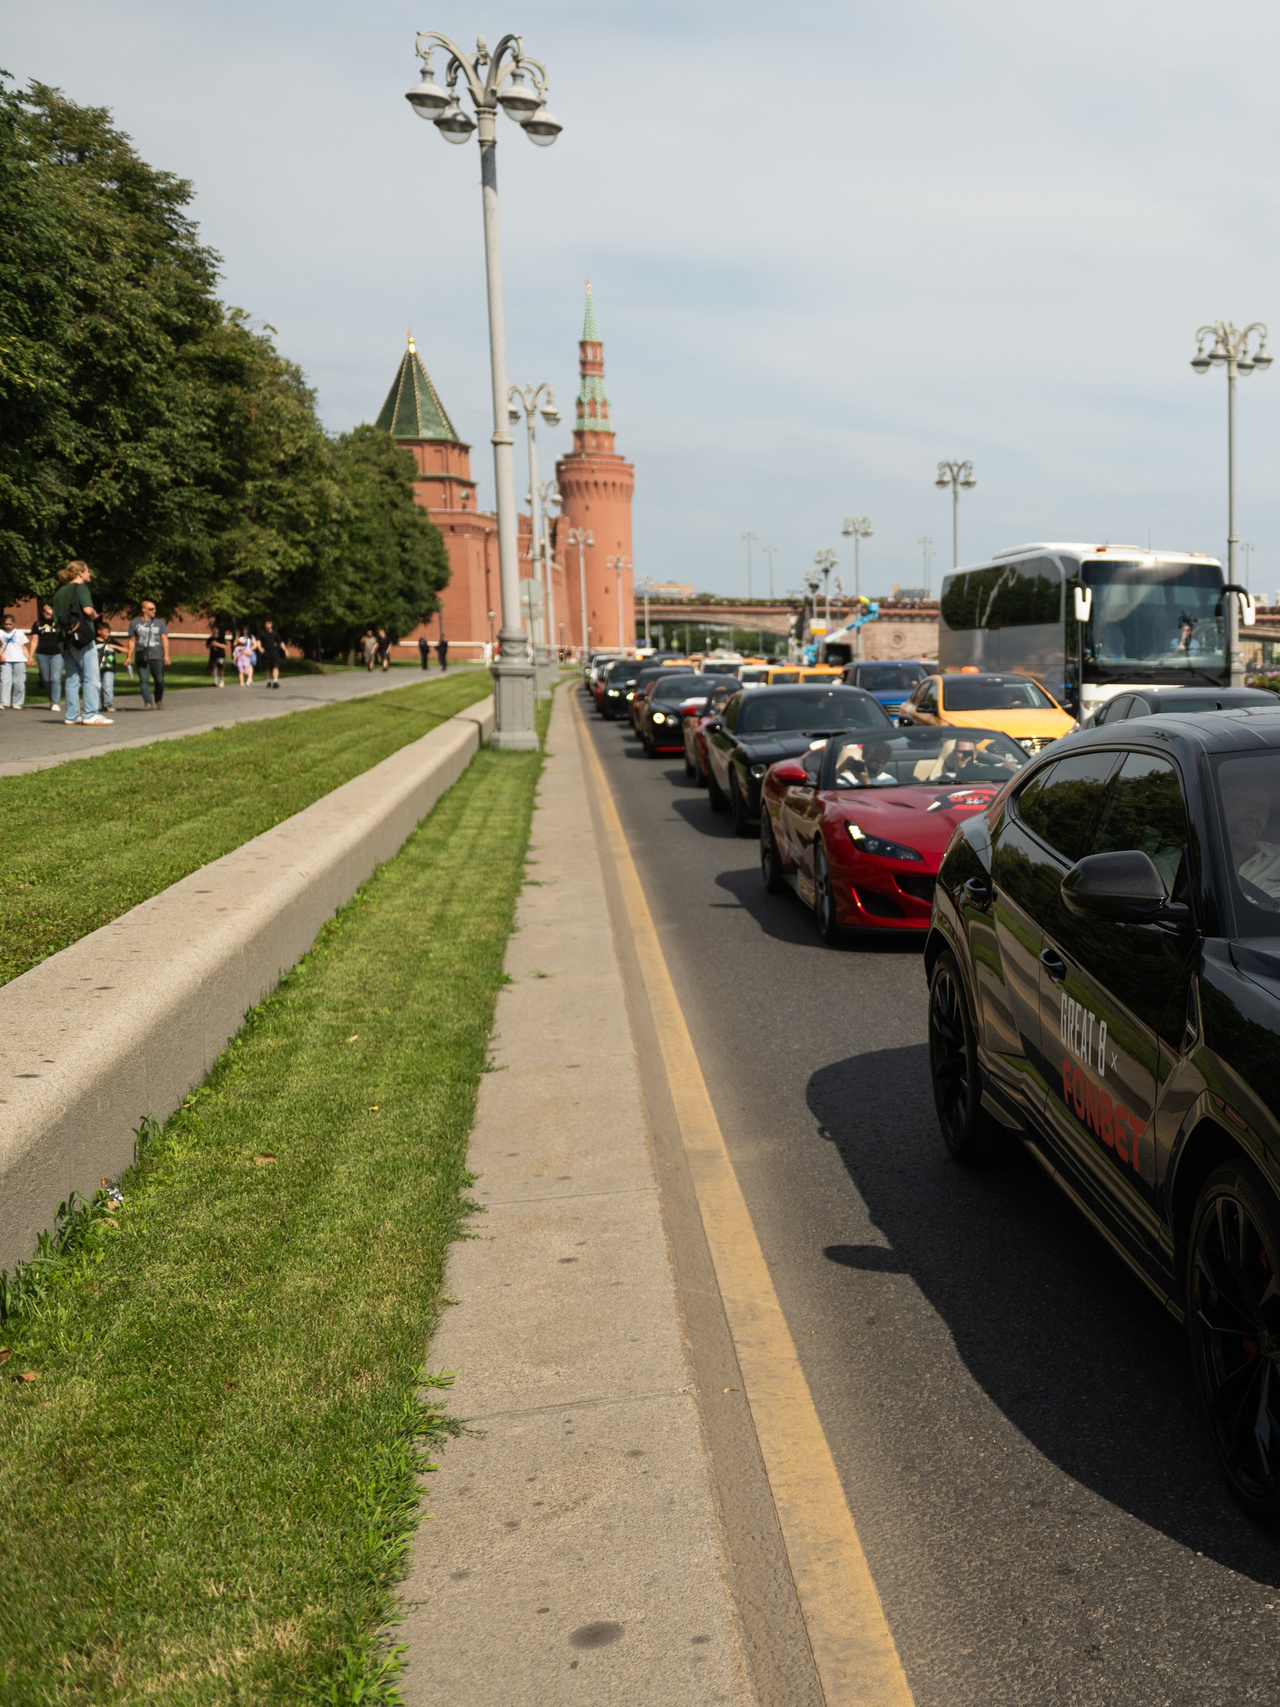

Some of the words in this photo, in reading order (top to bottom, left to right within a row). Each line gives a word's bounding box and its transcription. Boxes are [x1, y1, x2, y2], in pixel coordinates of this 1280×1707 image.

[1060, 992, 1096, 1067] GREAT
[1097, 1019, 1108, 1077] 8
[1062, 1057, 1146, 1174] FONBET
